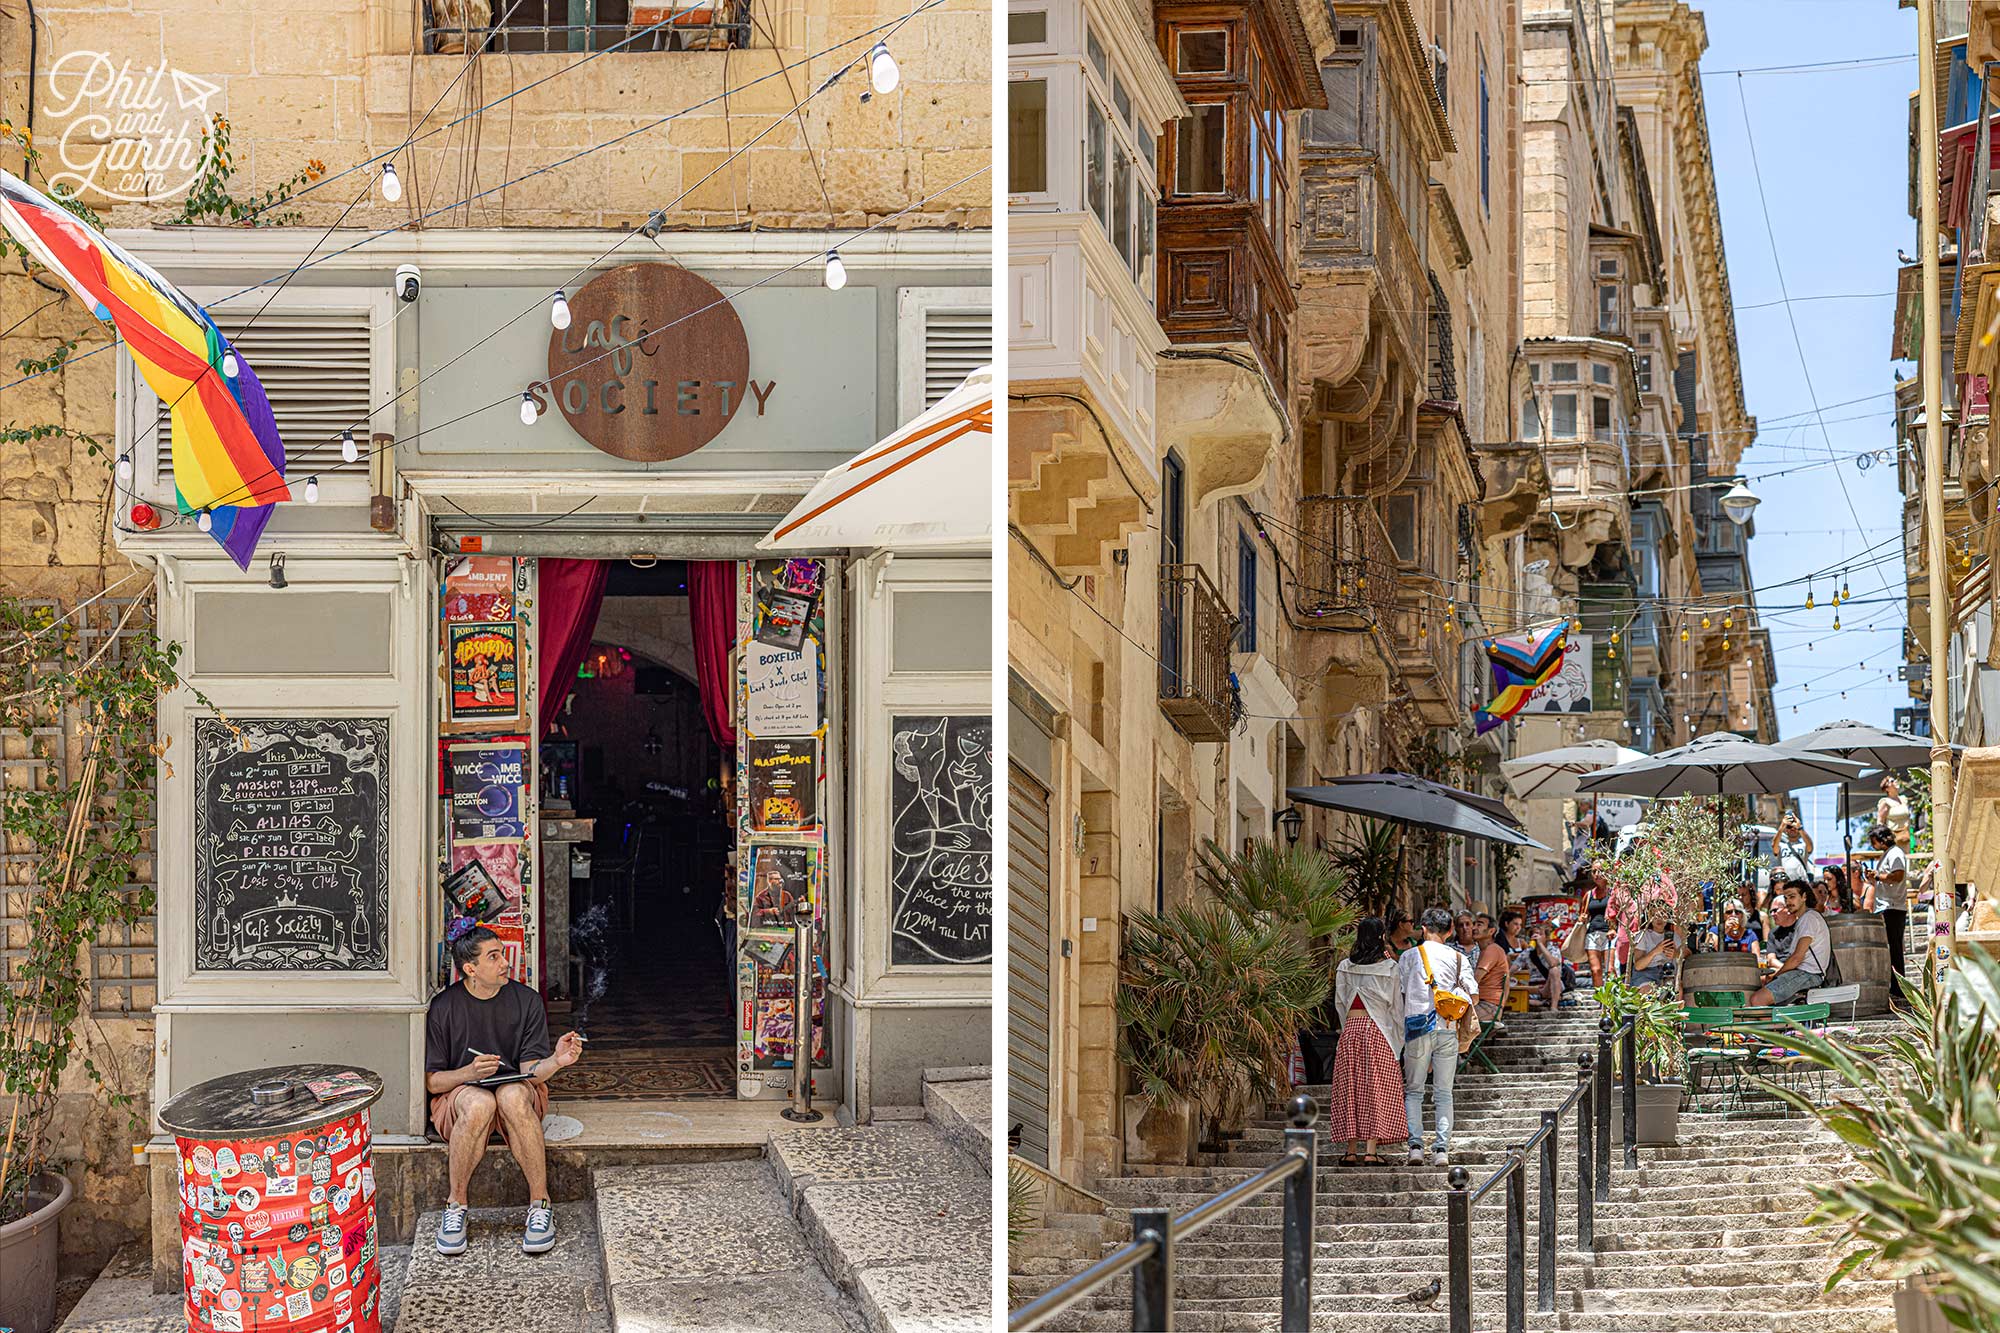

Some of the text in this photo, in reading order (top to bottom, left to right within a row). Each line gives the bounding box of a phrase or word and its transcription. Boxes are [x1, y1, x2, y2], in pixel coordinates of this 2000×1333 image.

[525, 379, 777, 417] SOCIETY
[454, 639, 514, 667] ABSURDO
[760, 651, 802, 665] BOXFISH
[261, 747, 321, 761] This Week
[501, 763, 521, 773] IMB
[289, 779, 319, 792] tape
[314, 786, 338, 795] ANTO
[256, 815, 311, 829] ALIAS
[929, 852, 992, 890] Cafe S
[240, 874, 339, 891] Lost Souls Club
[951, 887, 971, 900] the
[912, 888, 948, 909] place
[946, 900, 971, 919] for
[295, 933, 329, 942] VALLETTA
[963, 922, 990, 941] LAT
